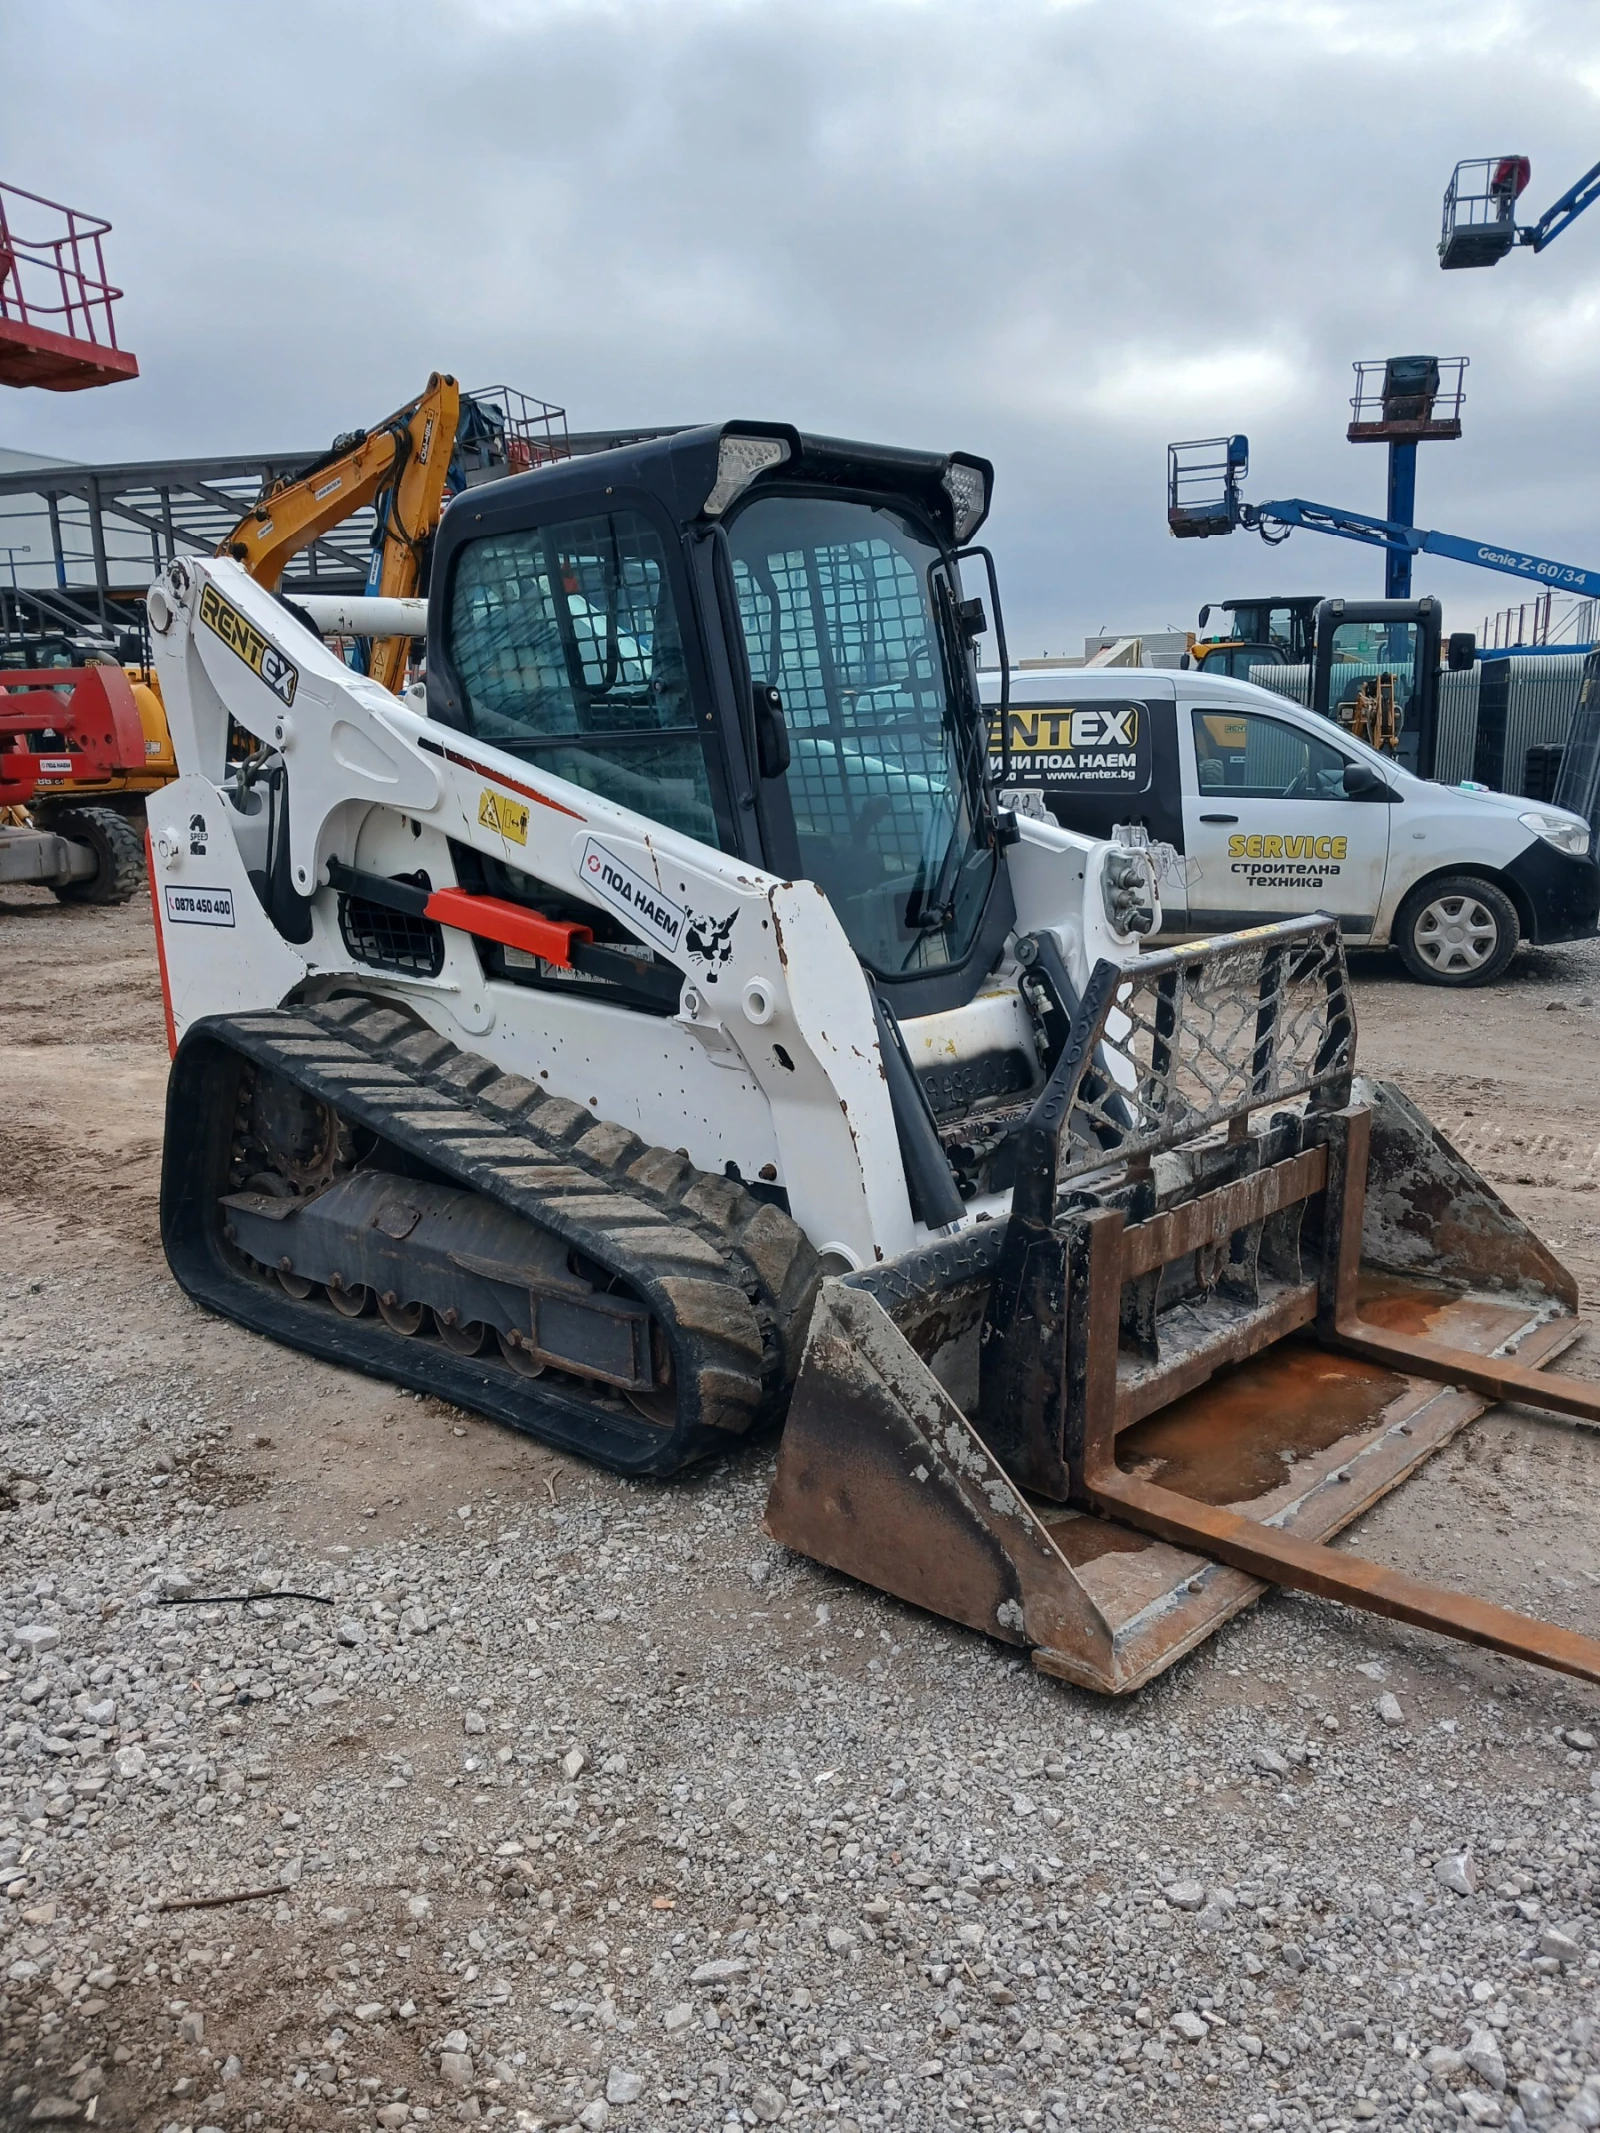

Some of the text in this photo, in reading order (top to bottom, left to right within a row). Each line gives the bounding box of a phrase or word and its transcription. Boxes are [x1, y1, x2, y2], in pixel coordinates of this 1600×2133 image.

[1478, 547, 1586, 585] Genie Z-60/34
[202, 588, 296, 701] RENTEX
[988, 710, 1133, 748] ENTEX
[1035, 755, 1075, 770] ПОД
[1079, 753, 1136, 768] НАЕМ
[1046, 770, 1136, 781] www.rentex.bg
[190, 833, 208, 841] SPEED
[1228, 834, 1347, 860] SERVICE
[1231, 863, 1340, 876] строителна
[1246, 876, 1323, 888] техника
[174, 897, 231, 915] 0878 450 400
[601, 864, 679, 938] ПОД НАЕМ
